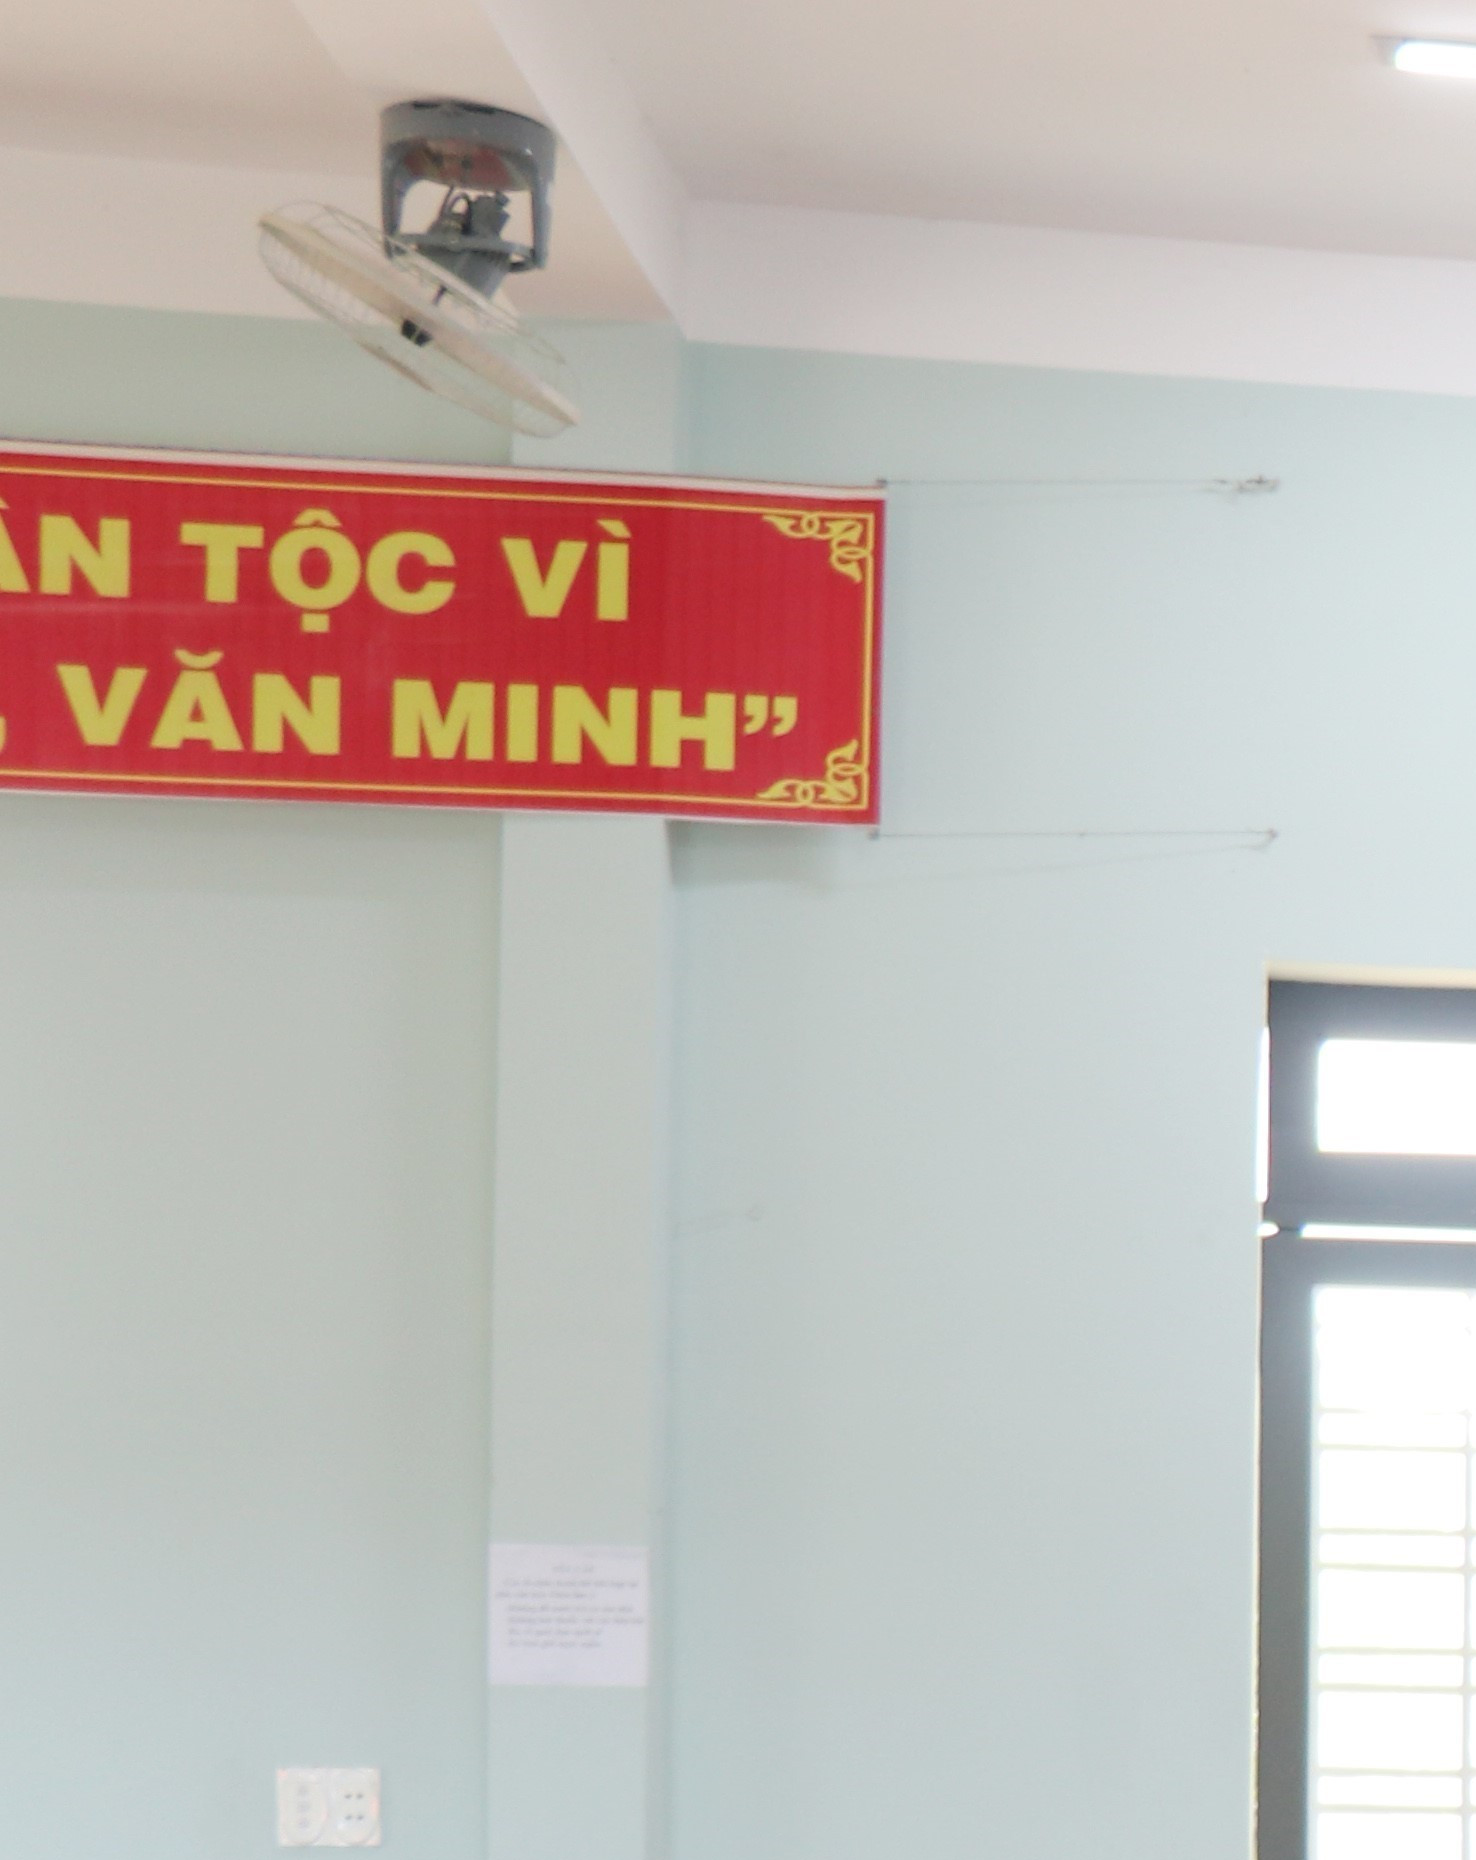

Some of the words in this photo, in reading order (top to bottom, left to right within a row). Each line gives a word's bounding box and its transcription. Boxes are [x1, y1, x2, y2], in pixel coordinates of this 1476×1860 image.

[180, 508, 457, 632] TỘC
[500, 519, 630, 622] VÌ
[56, 649, 342, 755] VĂN
